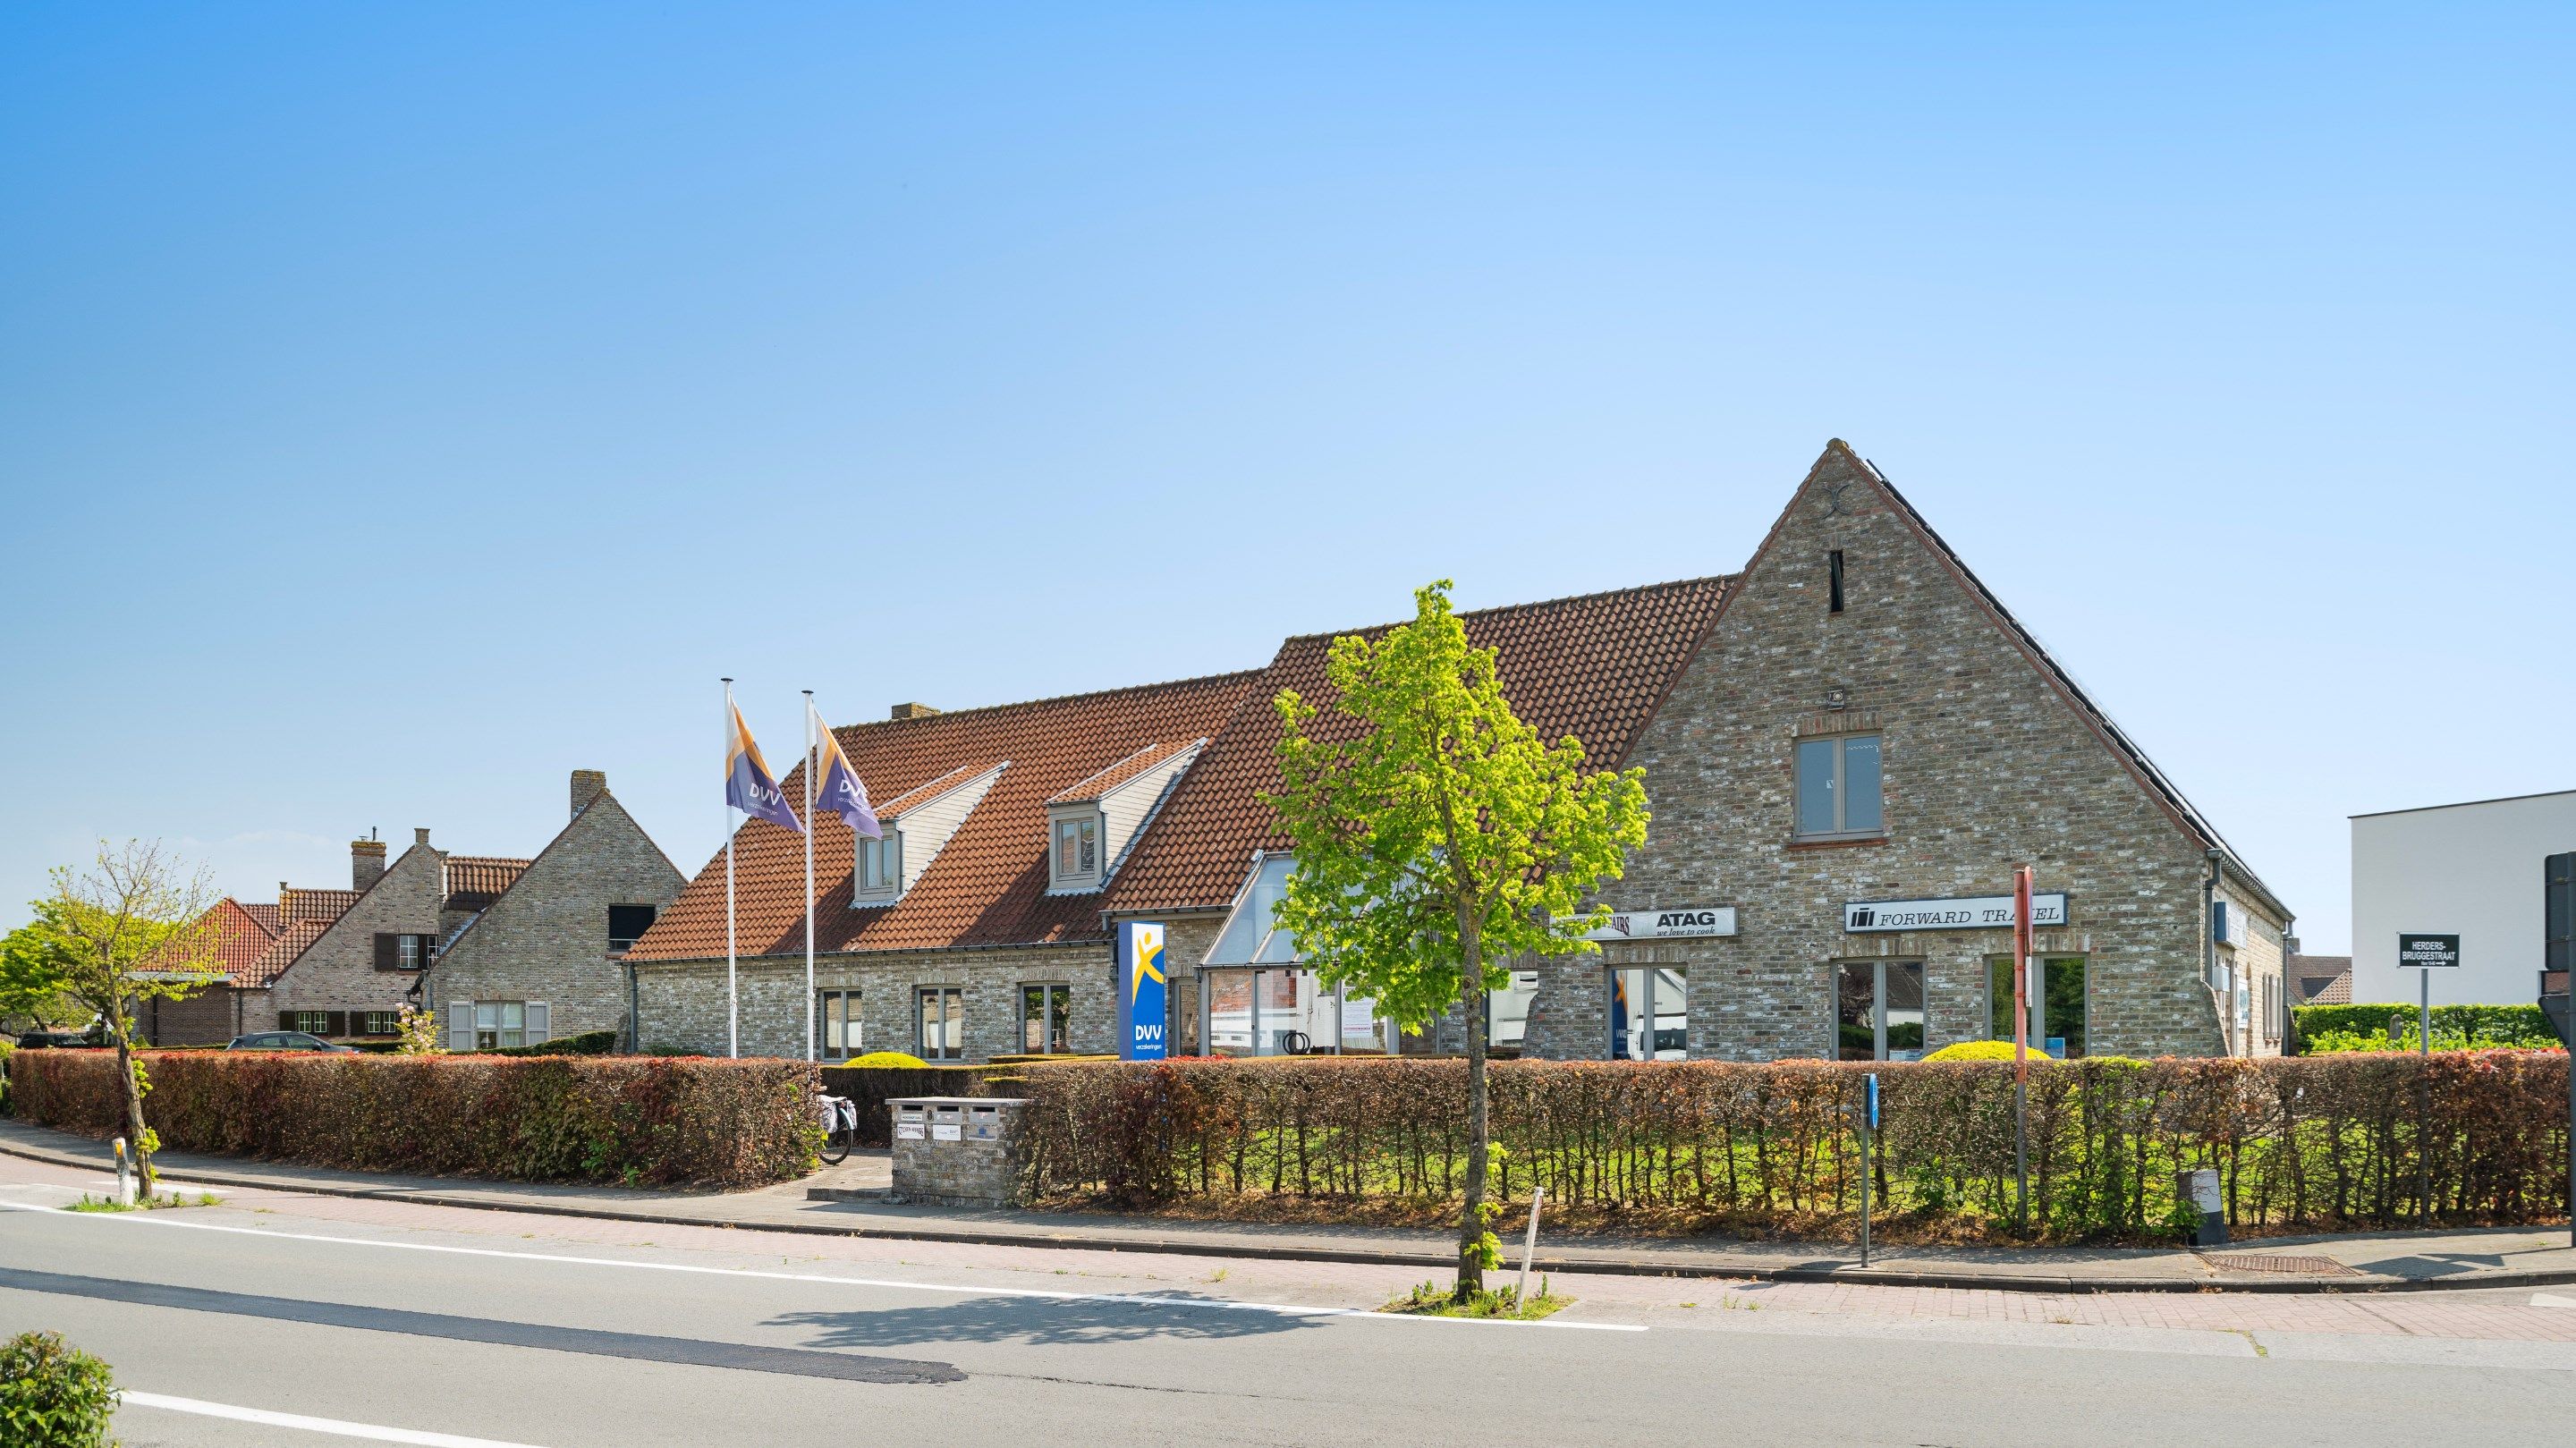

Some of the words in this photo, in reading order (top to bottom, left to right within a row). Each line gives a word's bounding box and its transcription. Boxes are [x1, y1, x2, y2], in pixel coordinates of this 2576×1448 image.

[750, 783, 781, 806] DVV
[1657, 911, 1716, 927] ATAG
[1878, 910, 1971, 927] FORWARD
[1982, 907, 2060, 922] TREL
[1669, 927, 1685, 936] love
[1696, 926, 1716, 936] cook
[2411, 941, 2446, 951] HERDERS-
[2402, 951, 2456, 961] BRUGGESTRAAT
[1135, 1024, 1162, 1041] DVV
